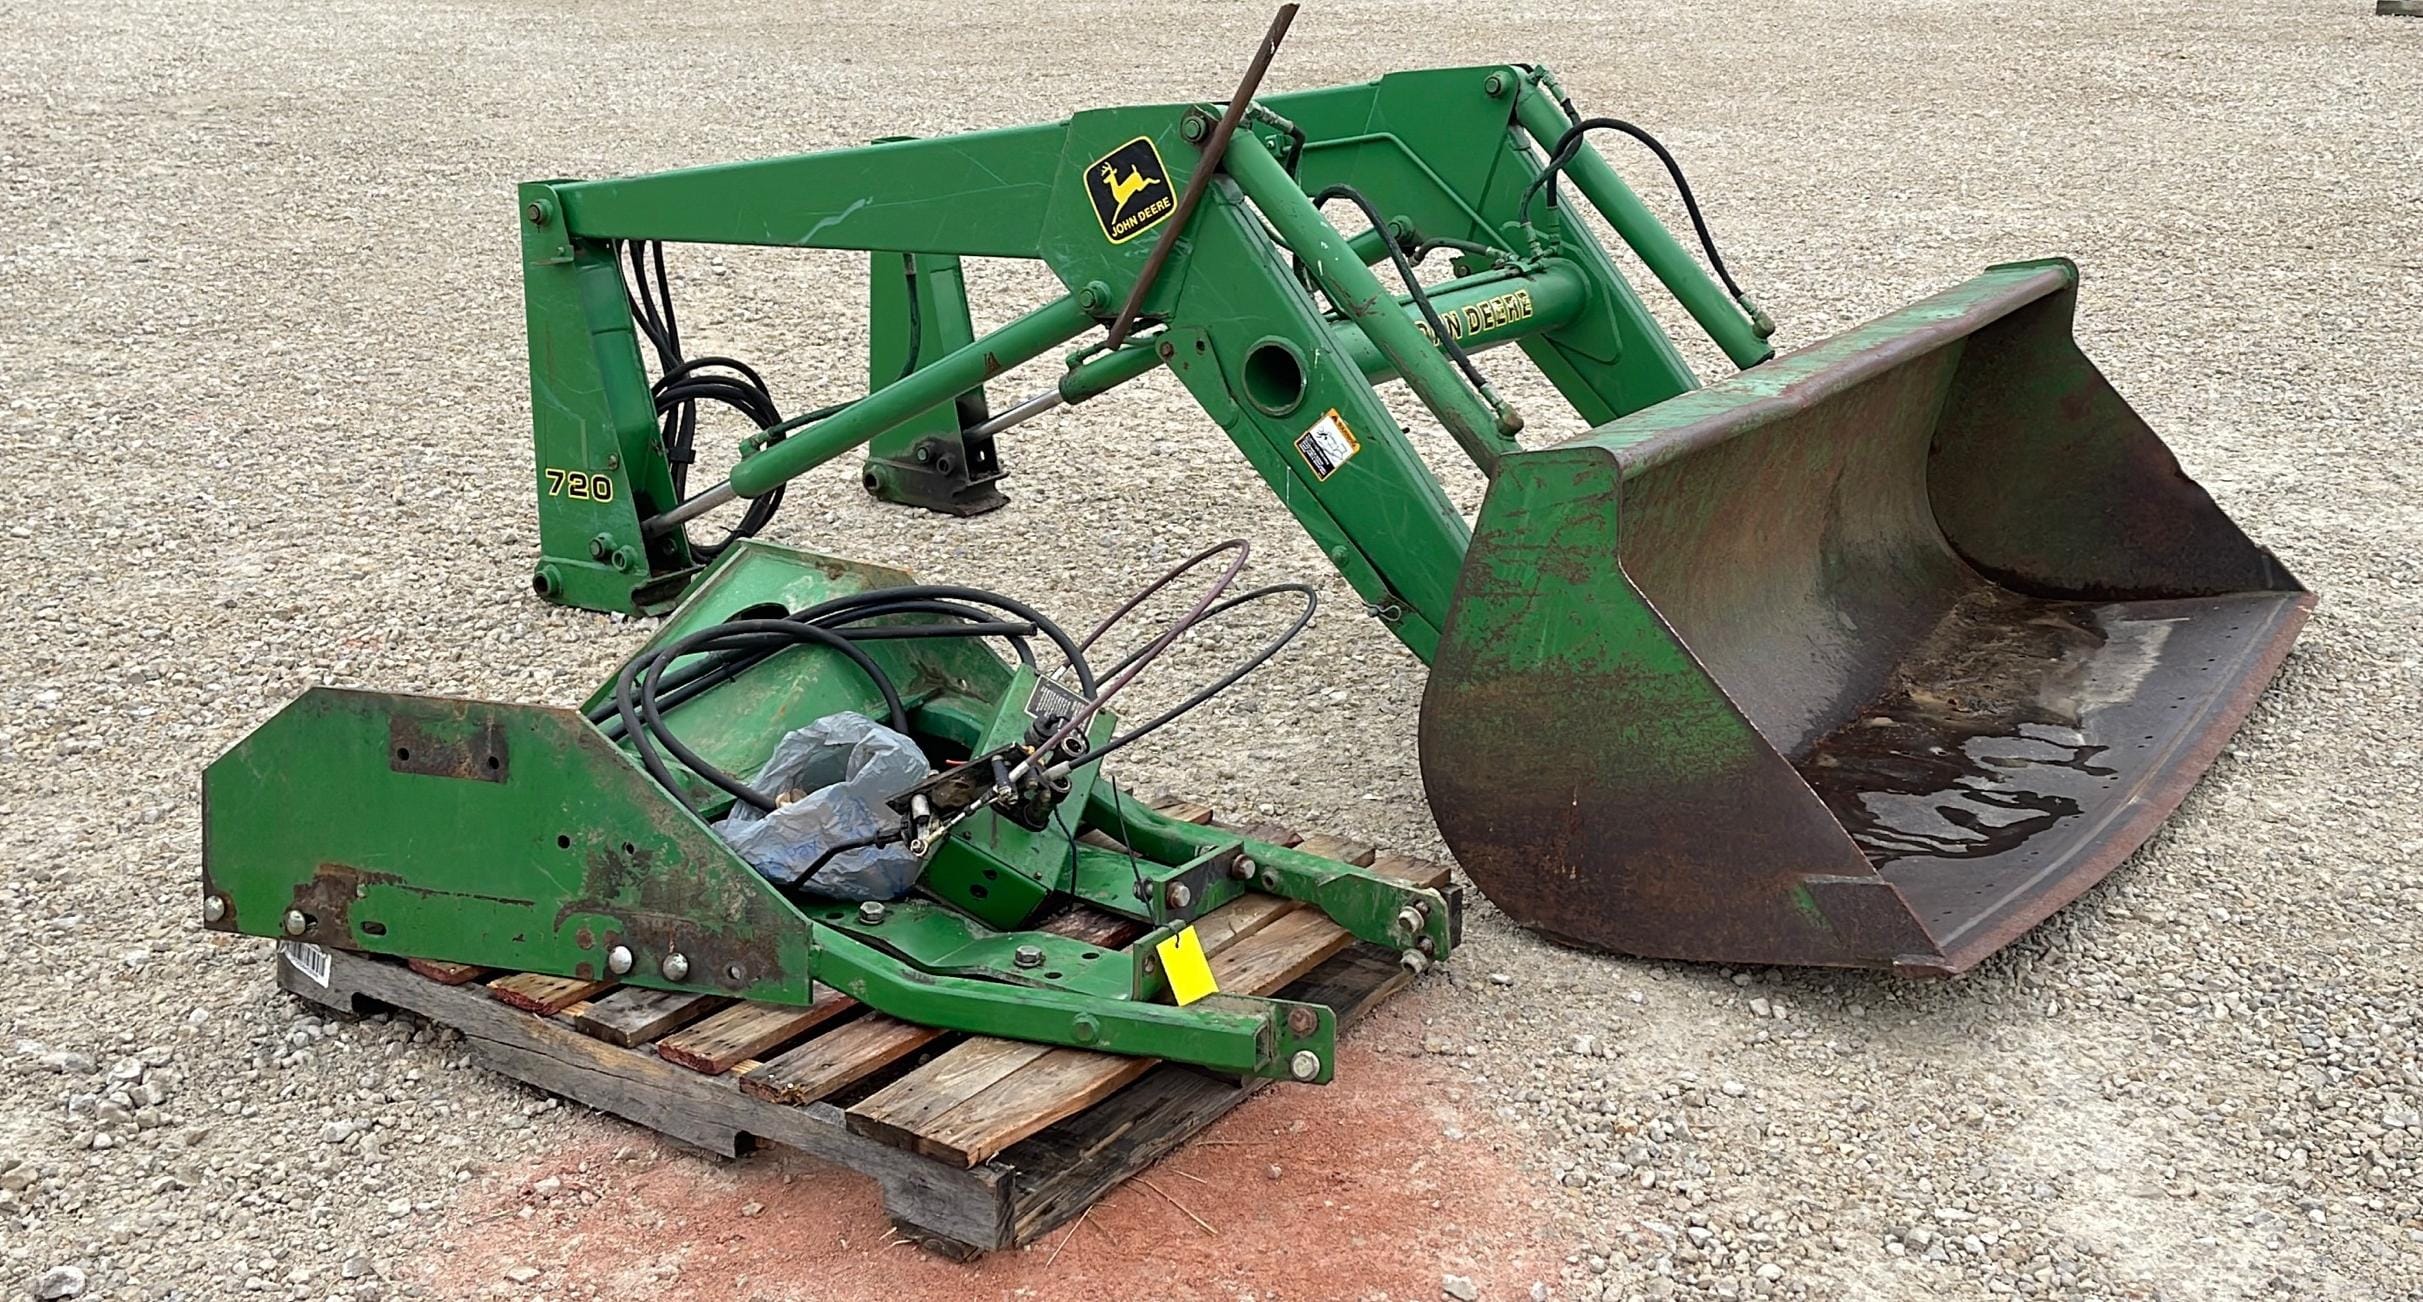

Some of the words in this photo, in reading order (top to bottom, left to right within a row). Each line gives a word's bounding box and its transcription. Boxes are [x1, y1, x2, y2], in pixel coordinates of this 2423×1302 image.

[1112, 215, 1138, 237] JOHN
[1137, 197, 1171, 222] DEERE
[1461, 289, 1533, 336] DEERE
[545, 468, 613, 503] 720
